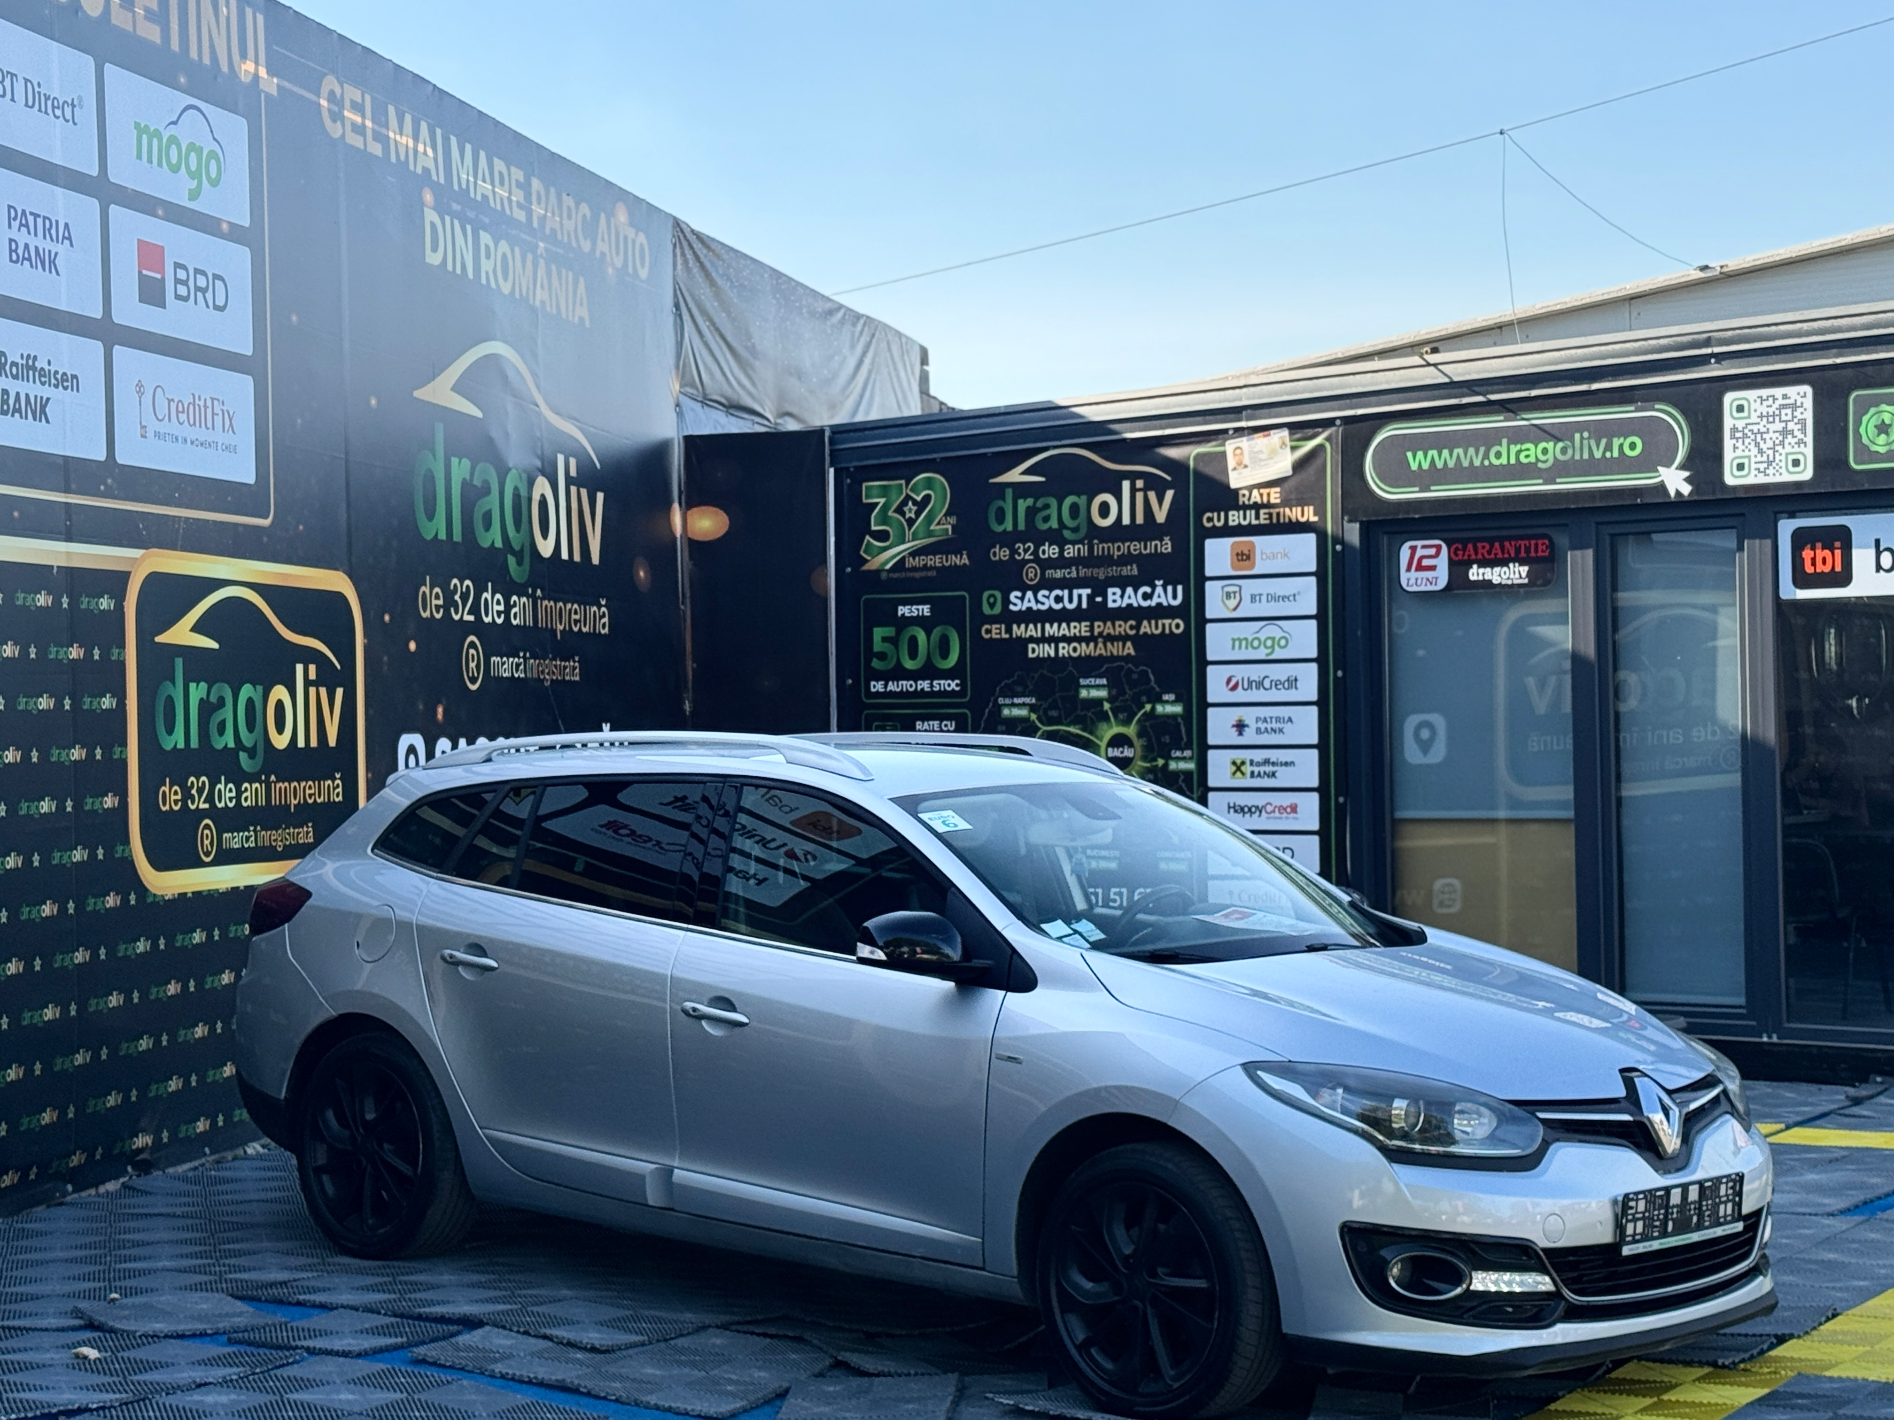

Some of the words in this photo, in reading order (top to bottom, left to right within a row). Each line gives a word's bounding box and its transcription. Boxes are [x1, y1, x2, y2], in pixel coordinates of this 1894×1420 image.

[133, 120, 223, 202] mogo
[319, 75, 383, 158] CEL
[388, 104, 445, 184] MAI
[450, 135, 526, 223] MARE
[531, 176, 591, 249] PARC
[595, 208, 649, 281] AUTO
[6, 203, 75, 249] PATRIA
[8, 237, 61, 277] BANK
[423, 205, 474, 281] DIN
[480, 236, 590, 328] ROMÂNIA
[173, 261, 229, 313] BRD
[0, 352, 80, 395] Raiffeisen
[0, 388, 51, 425] BANK
[151, 384, 237, 436] CreditFix
[1406, 430, 1643, 472] www.dragoliv.ro
[414, 422, 605, 583] dragoliv
[1238, 487, 1281, 505] RATE
[988, 480, 1175, 540] dragoliv
[1203, 509, 1226, 527] CU
[1227, 506, 1319, 526] BULETINUL
[905, 551, 969, 568] ÎMPREUNĂ
[990, 544, 1010, 560] de
[1014, 543, 1034, 560] 32
[1039, 541, 1059, 558] de
[1064, 540, 1088, 557] ani
[1093, 537, 1172, 559] împreună
[1235, 549, 1251, 562] tbi
[1260, 549, 1290, 561] bank
[1405, 544, 1442, 573] 12
[1449, 539, 1550, 560] GARANTIE
[1801, 541, 1842, 575] tbi
[1046, 567, 1077, 579] marcă
[1079, 564, 1138, 579] înregistrată
[1406, 577, 1439, 588] LUNI
[1468, 562, 1529, 584] dragoliv
[15, 591, 53, 610] dragoliv
[80, 594, 115, 613] dragoliv
[1008, 588, 1091, 611] SASCUT
[1107, 581, 1183, 608] BACĂU
[1225, 591, 1238, 601] BT
[1250, 594, 1264, 604] BT
[418, 576, 444, 619] de
[450, 578, 475, 622] 32
[481, 582, 505, 625] de
[510, 588, 533, 627] ani
[537, 592, 609, 640] împreună
[897, 605, 931, 617] PESTE
[981, 624, 1009, 639] CEL
[1012, 622, 1042, 638] MAI
[1044, 621, 1091, 637] MARE
[1094, 620, 1136, 636] PARC
[1139, 619, 1184, 635] AUTO
[48, 644, 85, 662] dragoliv
[870, 625, 961, 671] 500
[1028, 643, 1055, 658] DIN
[1058, 638, 1136, 657] ROMÂNIA
[1231, 636, 1290, 657] mogo
[490, 651, 525, 679] marcă
[870, 681, 884, 692] DE
[886, 681, 916, 692] AUTO
[917, 680, 931, 691] PE
[932, 679, 961, 691] STOC
[1241, 676, 1298, 692] UniCredit
[17, 693, 56, 714] dragoliv
[82, 694, 118, 713] dragoliv
[155, 657, 344, 773] dragoliv
[916, 721, 938, 731] RATE
[940, 720, 955, 731] CU
[1255, 716, 1294, 725] PATRIA
[1255, 727, 1285, 736] BANK
[50, 746, 87, 765] dragoliv
[1107, 746, 1136, 758] BACĂU
[1249, 758, 1295, 767] Raiffeisen
[1249, 770, 1278, 779] BANK
[159, 778, 182, 811] de
[187, 776, 210, 810] 32
[215, 776, 236, 808] de
[241, 775, 266, 807] ani
[269, 773, 343, 812] împreună
[19, 797, 58, 817] dragoliv
[84, 793, 120, 813] dragoliv
[1227, 802, 1298, 818] HappyCredit
[223, 831, 256, 849] marcă
[257, 822, 314, 851] înregistrată
[51, 846, 90, 867] dragoliv
[20, 900, 59, 922] dragoliv
[86, 892, 122, 914] dragoliv
[53, 947, 91, 968] dragoliv
[117, 937, 152, 959] dragoliv
[175, 929, 208, 949] dragoliv
[22, 1005, 61, 1026] dragoliv
[88, 991, 125, 1012] dragoliv
[149, 980, 182, 1001] dragoliv
[205, 970, 237, 990] dragoliv
[53, 1049, 92, 1073] dragoliv
[119, 1035, 155, 1056] dragoliv
[178, 1022, 210, 1043] dragoliv
[20, 1107, 59, 1132] dragoliv
[86, 1091, 124, 1114] dragoliv
[148, 1076, 184, 1098] dragoliv
[178, 1116, 211, 1138] dragoliv
